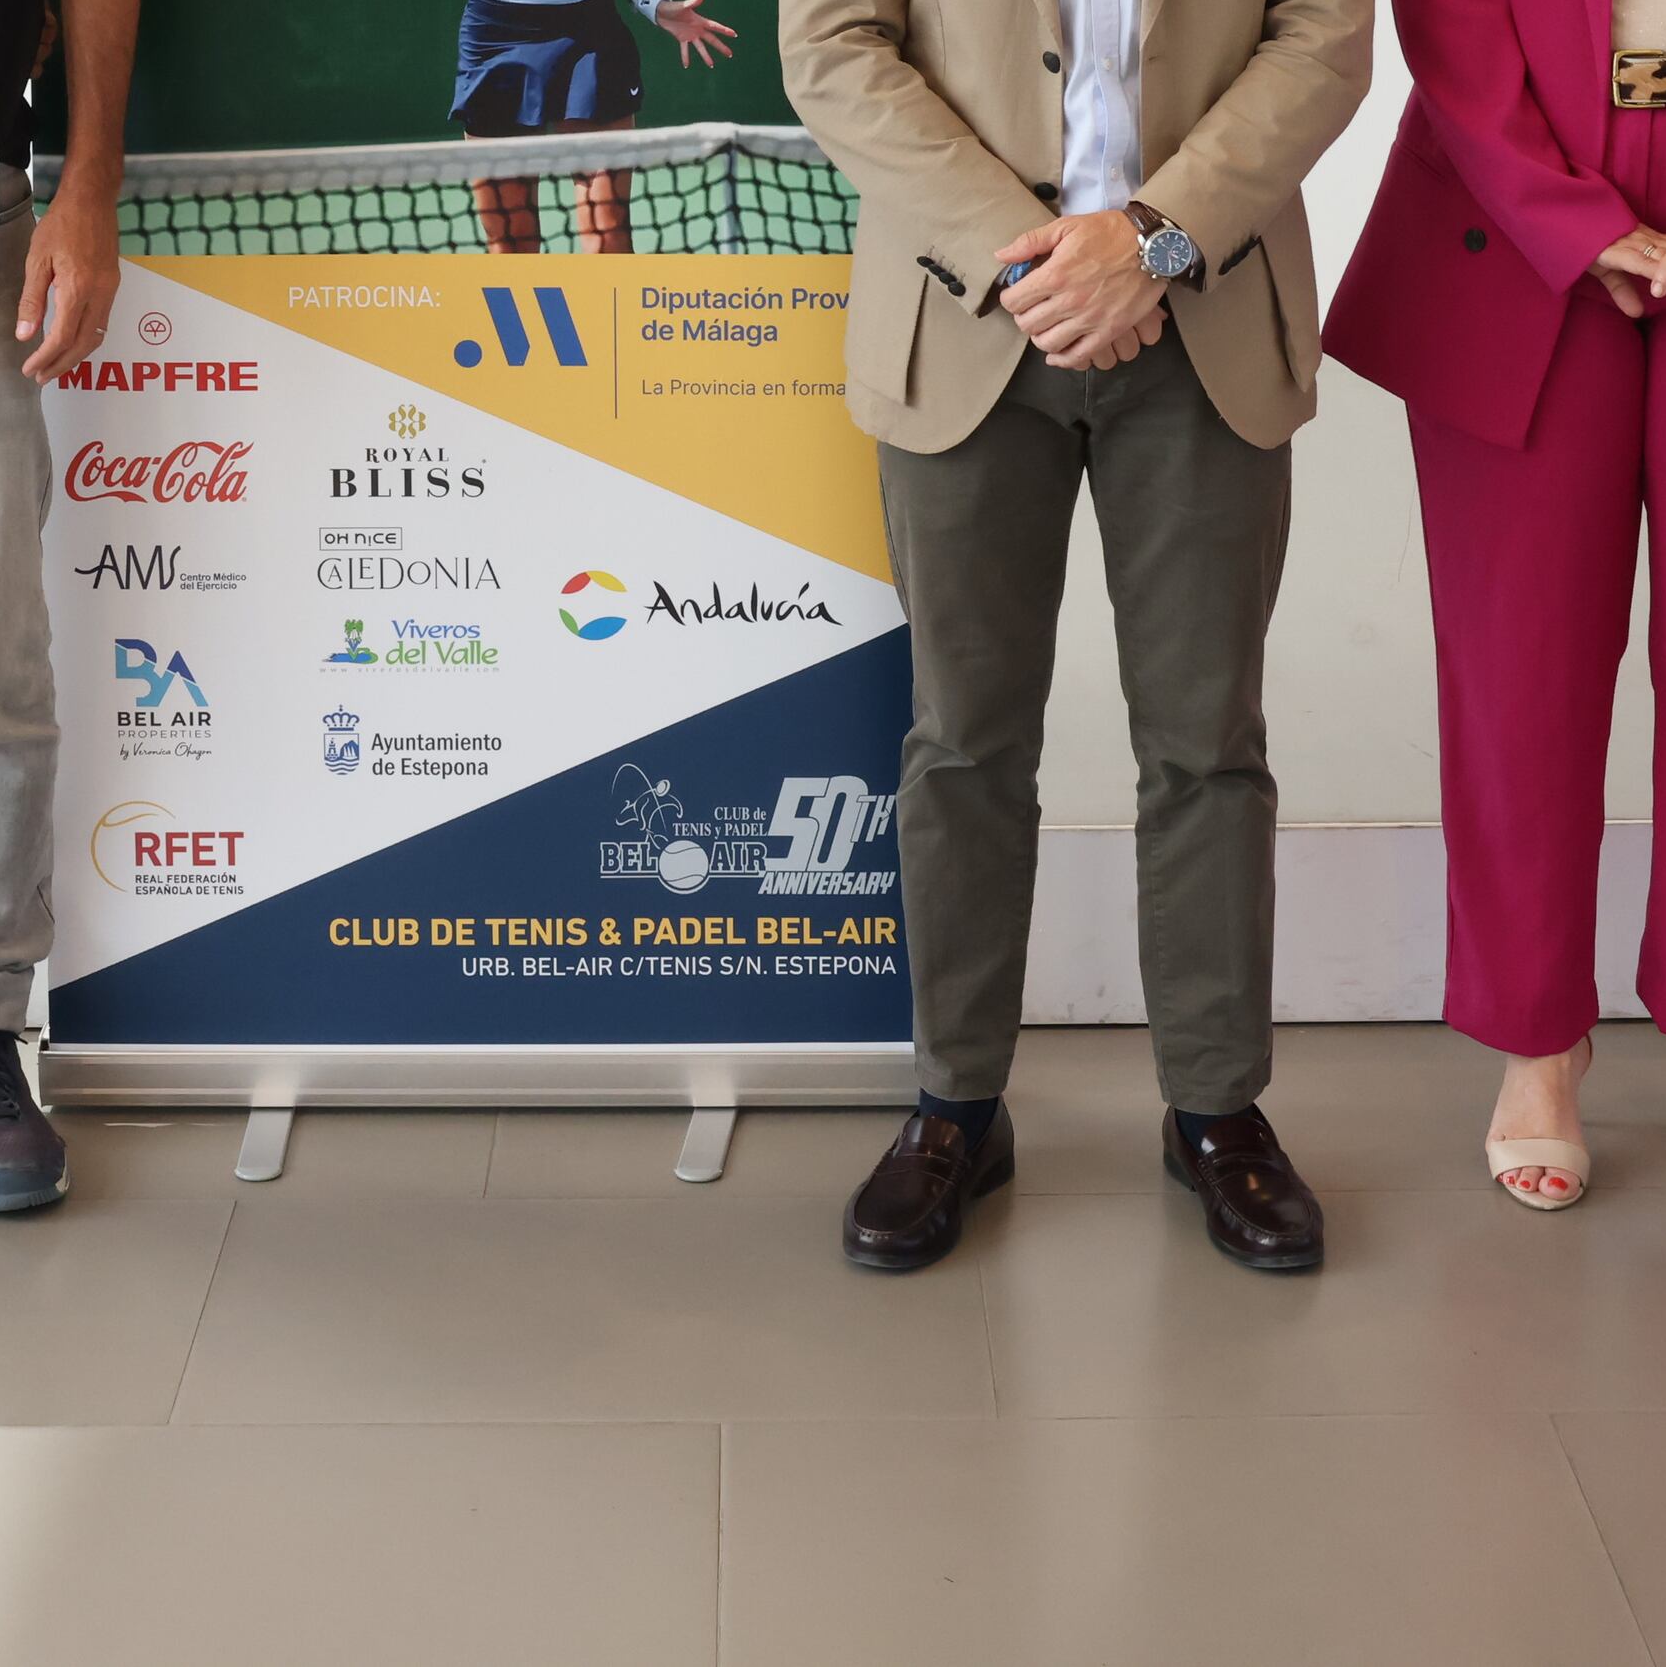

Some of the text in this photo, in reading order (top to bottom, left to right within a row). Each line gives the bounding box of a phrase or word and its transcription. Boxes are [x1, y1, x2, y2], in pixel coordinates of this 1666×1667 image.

[288, 286, 442, 309] PATROCINA:
[641, 286, 784, 314] Diputación
[641, 318, 779, 347] de Málaga
[57, 361, 259, 392] MAPFRE
[642, 379, 663, 396] La
[670, 379, 757, 396] Provincia
[763, 383, 786, 396] en
[365, 447, 450, 464] ROYAL
[64, 440, 255, 504] Coca-Cola
[329, 467, 486, 498] BLISS
[180, 572, 247, 583] Centro Médico
[317, 556, 501, 590] CALEDONIA
[180, 581, 238, 593] del Ejercicio
[643, 580, 845, 627] Andalucía
[390, 618, 481, 639] Viveros
[385, 640, 499, 665] del Valle
[117, 711, 212, 727] BEL AIR
[118, 729, 212, 739] PROPERTIES
[371, 732, 503, 755] Ayuntamiento
[120, 743, 130, 761] by
[372, 757, 489, 780] de Estepona
[714, 806, 767, 821] CLUB de
[672, 822, 768, 840] TENIS y PADEL
[135, 831, 245, 867] RFET
[599, 841, 768, 873] BEL AIR
[135, 871, 237, 884] REAL FEDERACIÓN
[758, 871, 896, 895] ANNIVERSARY
[135, 884, 244, 896] ESPAÑOLA DE TENIS
[329, 916, 897, 946] CLUB DE TENIS & PADEL BEL-AIR
[462, 955, 897, 977] URB. BEL-AIR C/TENIS S/N. ESTEPONA
